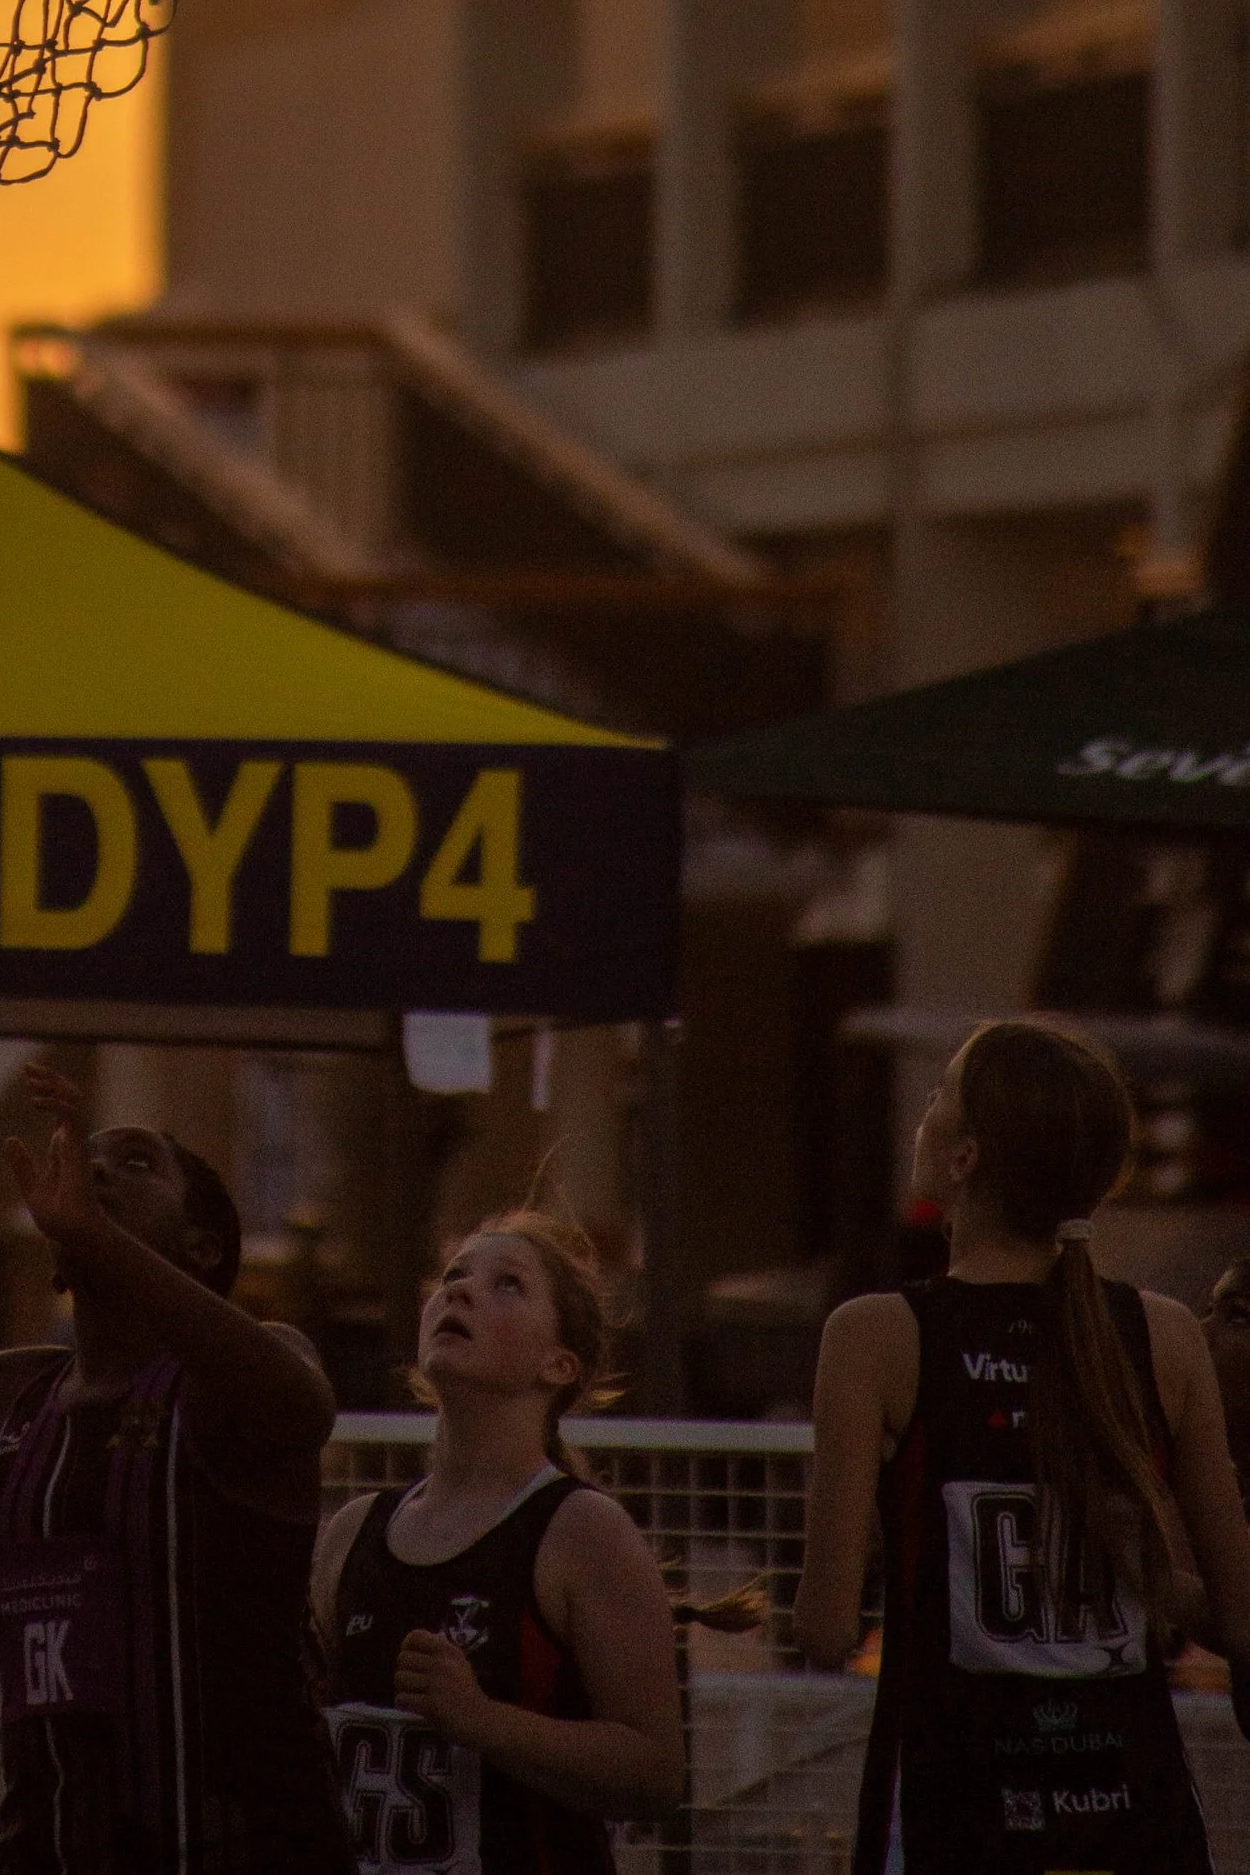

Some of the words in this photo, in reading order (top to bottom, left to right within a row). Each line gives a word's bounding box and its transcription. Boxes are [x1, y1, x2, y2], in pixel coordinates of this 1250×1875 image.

[23, 1619, 75, 1706] GK
[1050, 1732, 1125, 1755] DUBAI
[328, 1719, 455, 1865] GS
[1051, 1783, 1133, 1815] Kubri
